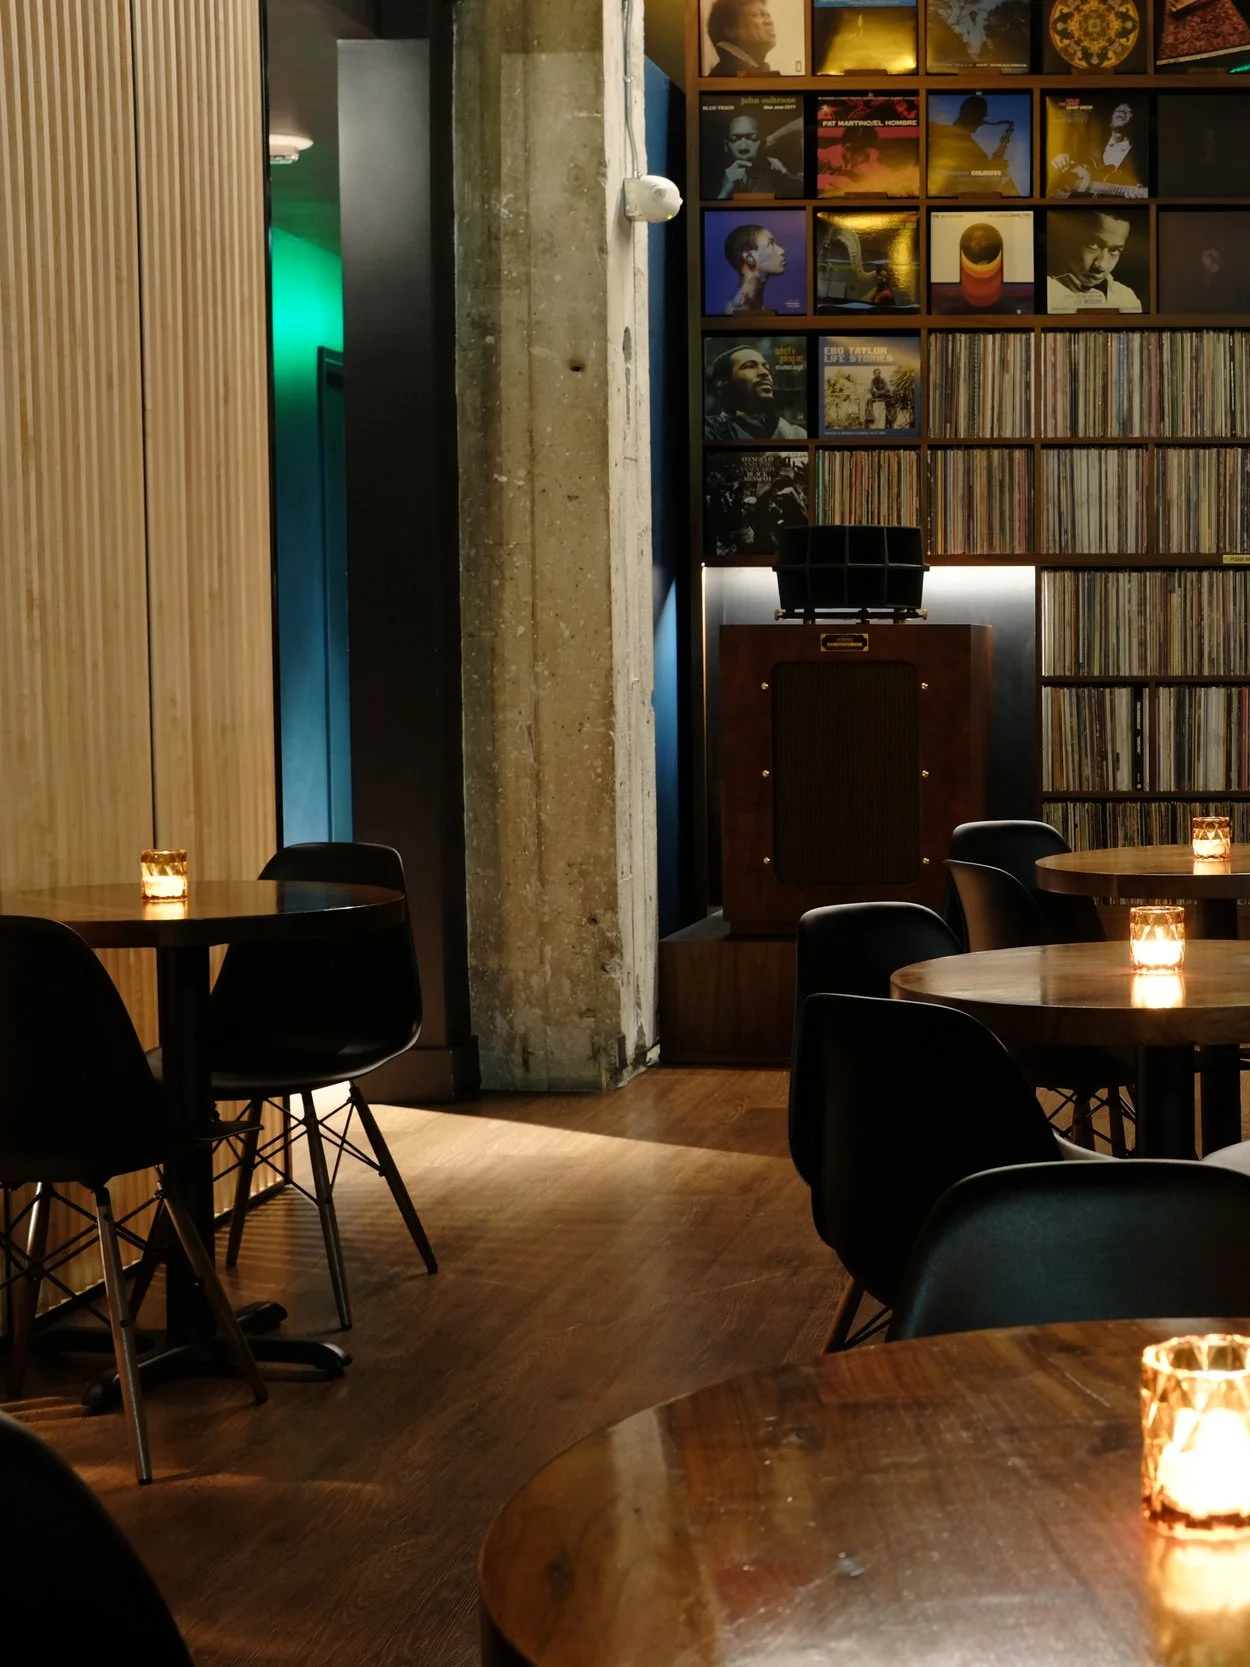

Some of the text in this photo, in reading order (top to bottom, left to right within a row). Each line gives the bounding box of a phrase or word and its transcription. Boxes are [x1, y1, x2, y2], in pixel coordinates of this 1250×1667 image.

[823, 346, 888, 355] EBO TAYLOR
[823, 355, 894, 363] LIFE STORIES
